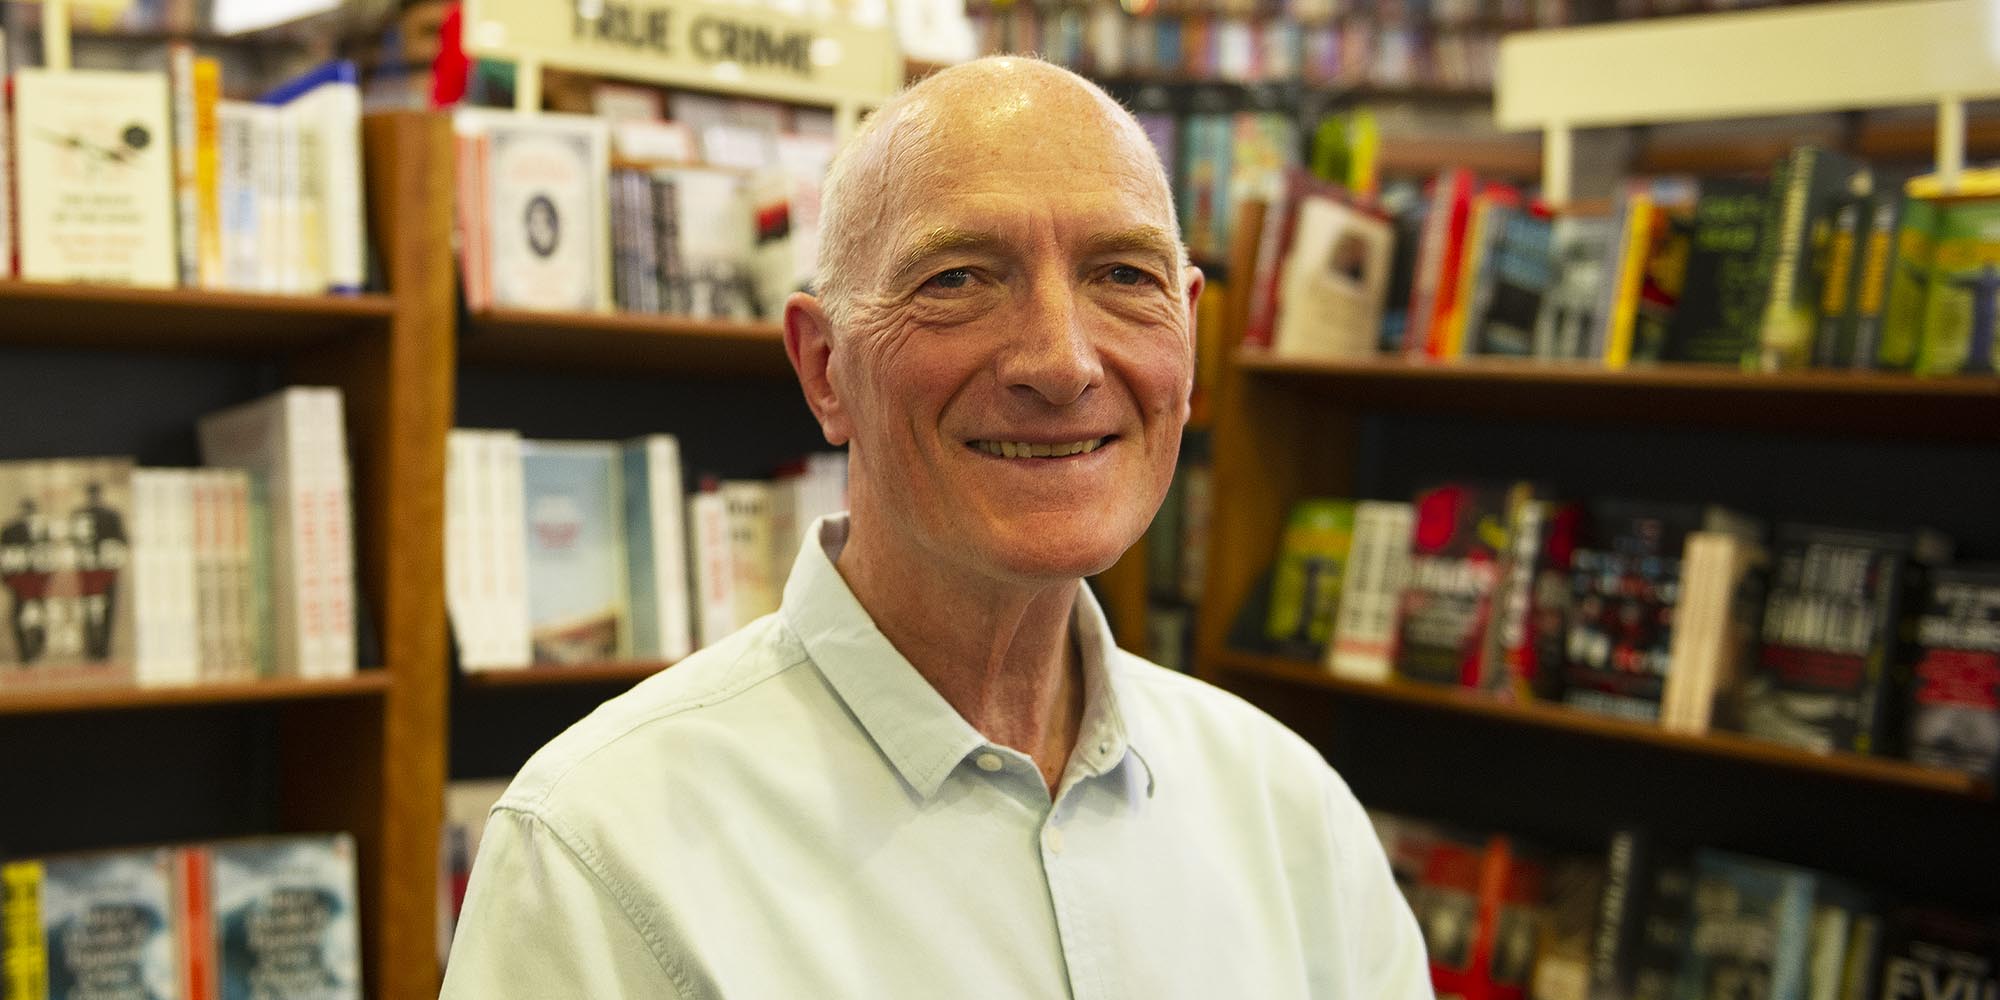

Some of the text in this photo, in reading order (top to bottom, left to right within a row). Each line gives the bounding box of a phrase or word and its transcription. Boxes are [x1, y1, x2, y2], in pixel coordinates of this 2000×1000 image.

[571, 0, 817, 76] TRUE CRIME
[29, 513, 96, 541] THE
[0, 540, 128, 572] WORLD
